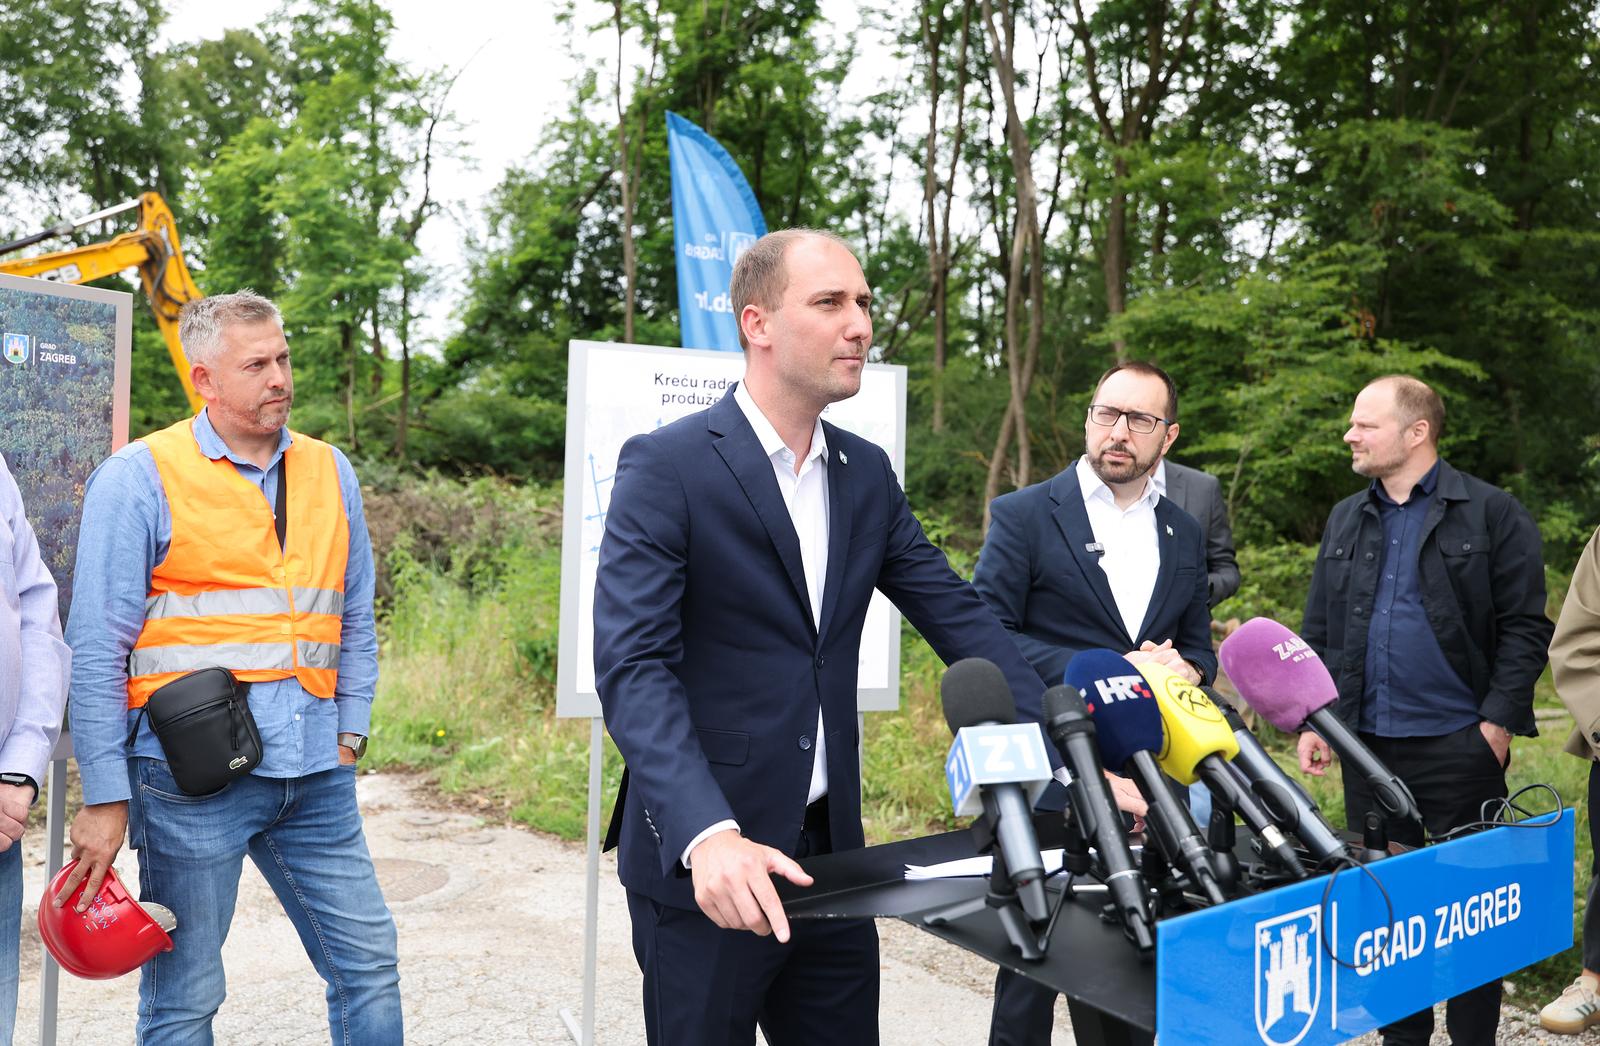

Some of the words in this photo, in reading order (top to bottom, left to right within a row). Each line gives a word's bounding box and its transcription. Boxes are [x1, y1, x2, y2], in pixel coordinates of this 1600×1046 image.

[33, 264, 82, 283] CB
[40, 342, 57, 351] GRAD
[40, 352, 76, 365] ZAGREB
[654, 373, 698, 388] Kreću
[1094, 675, 1151, 704] HRT
[978, 733, 1038, 773] Z1
[949, 746, 968, 801] Z1
[1354, 915, 1426, 976] GRAD
[1434, 882, 1521, 949] ZAGREB
